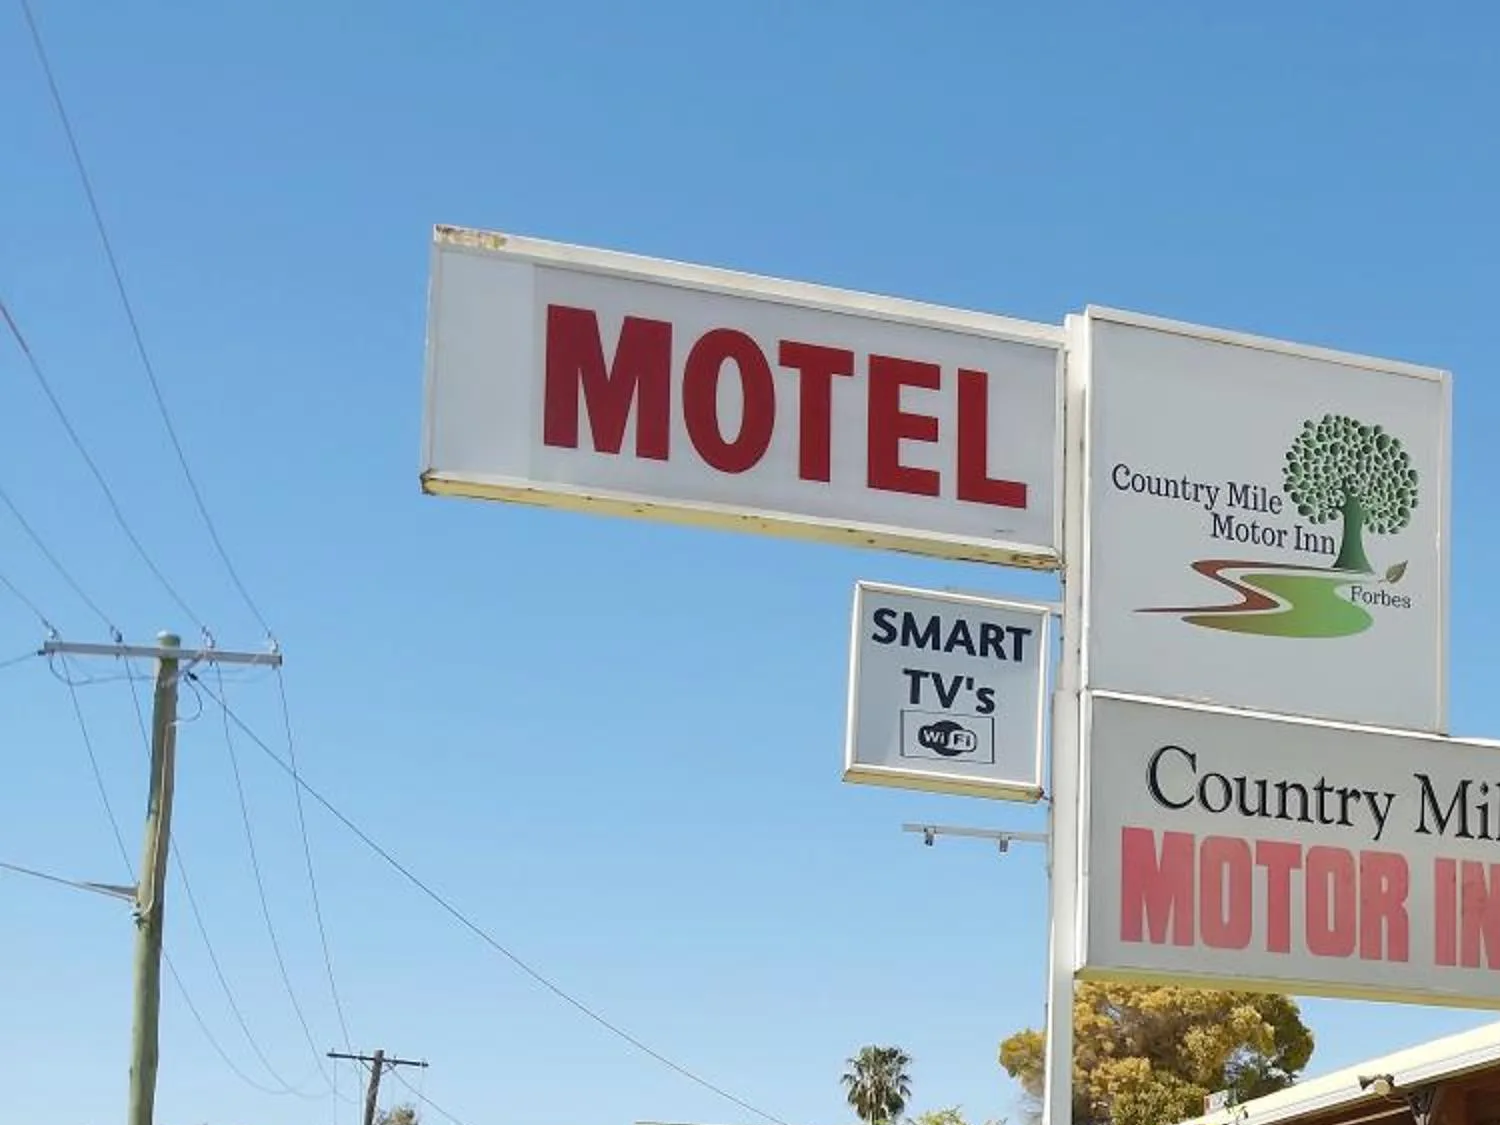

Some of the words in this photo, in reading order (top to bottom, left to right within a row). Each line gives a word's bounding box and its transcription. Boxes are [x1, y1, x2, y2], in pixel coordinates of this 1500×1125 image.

[543, 303, 1027, 509] MOTEL
[1112, 463, 1219, 511] Country
[1227, 481, 1283, 514] Mile
[1210, 513, 1288, 549] Motor
[1294, 525, 1337, 555] Inn
[1350, 586, 1412, 609] Forbes
[871, 608, 1032, 662] SMART
[902, 668, 996, 714] TV's
[1146, 745, 1396, 841] Country
[1120, 826, 1410, 963] MOTOR
